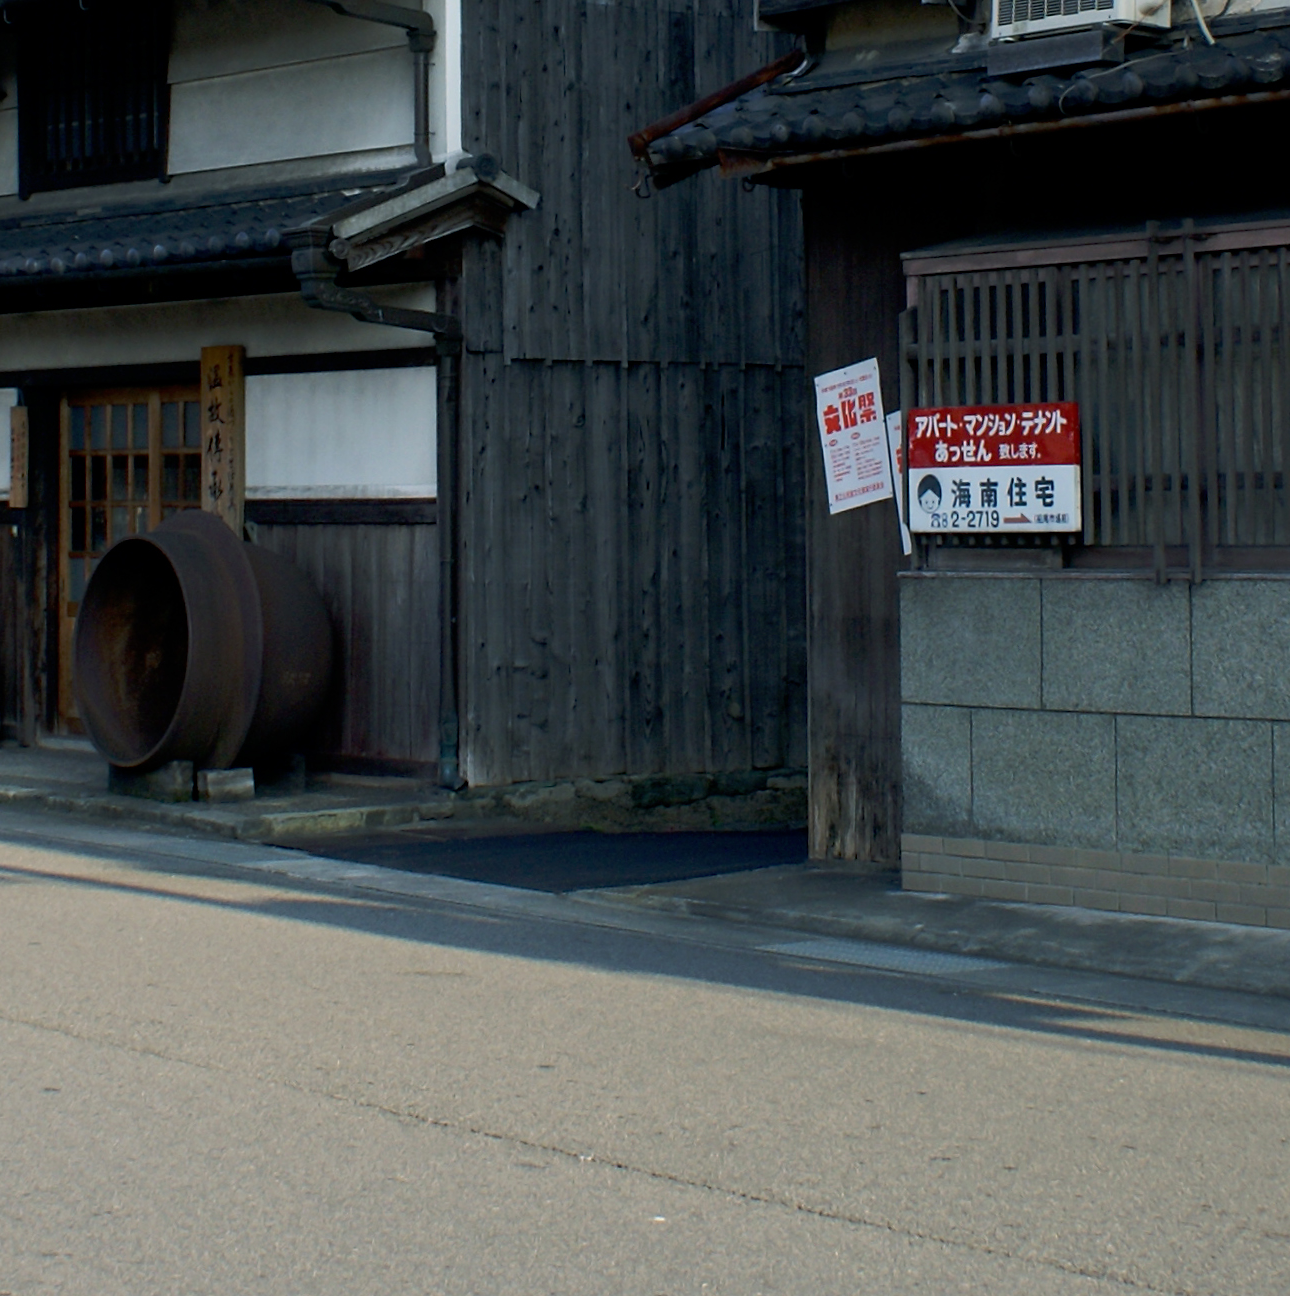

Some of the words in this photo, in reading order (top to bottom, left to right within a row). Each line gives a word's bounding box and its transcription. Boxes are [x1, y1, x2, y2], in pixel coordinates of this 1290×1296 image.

[822, 391, 877, 435] 文化祭
[934, 439, 992, 463] あっせん
[951, 476, 1055, 509] 海南住宅
